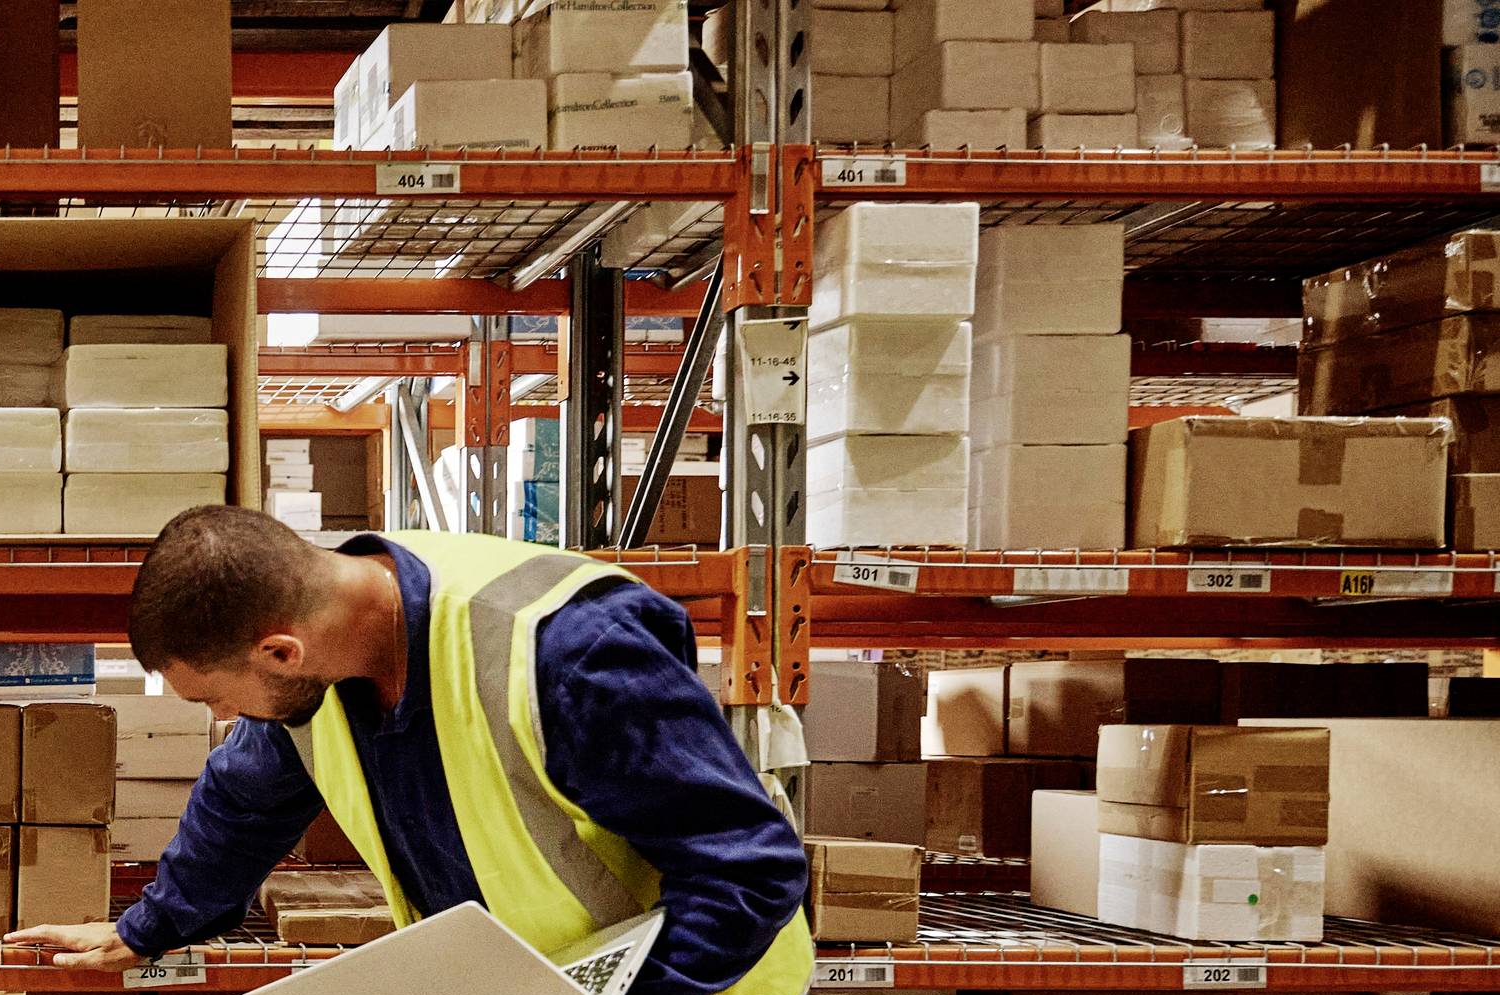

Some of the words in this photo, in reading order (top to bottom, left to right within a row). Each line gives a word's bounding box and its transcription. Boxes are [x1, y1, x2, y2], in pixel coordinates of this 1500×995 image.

[397, 174, 425, 188] 404
[837, 169, 864, 183] 401
[751, 357, 796, 367] 11-16-45
[751, 413, 797, 422] 11-16-35
[852, 567, 879, 582] 301
[1206, 573, 1234, 588] 302
[140, 966, 167, 979] 205
[828, 968, 854, 982] 201
[1203, 967, 1231, 982] 202
